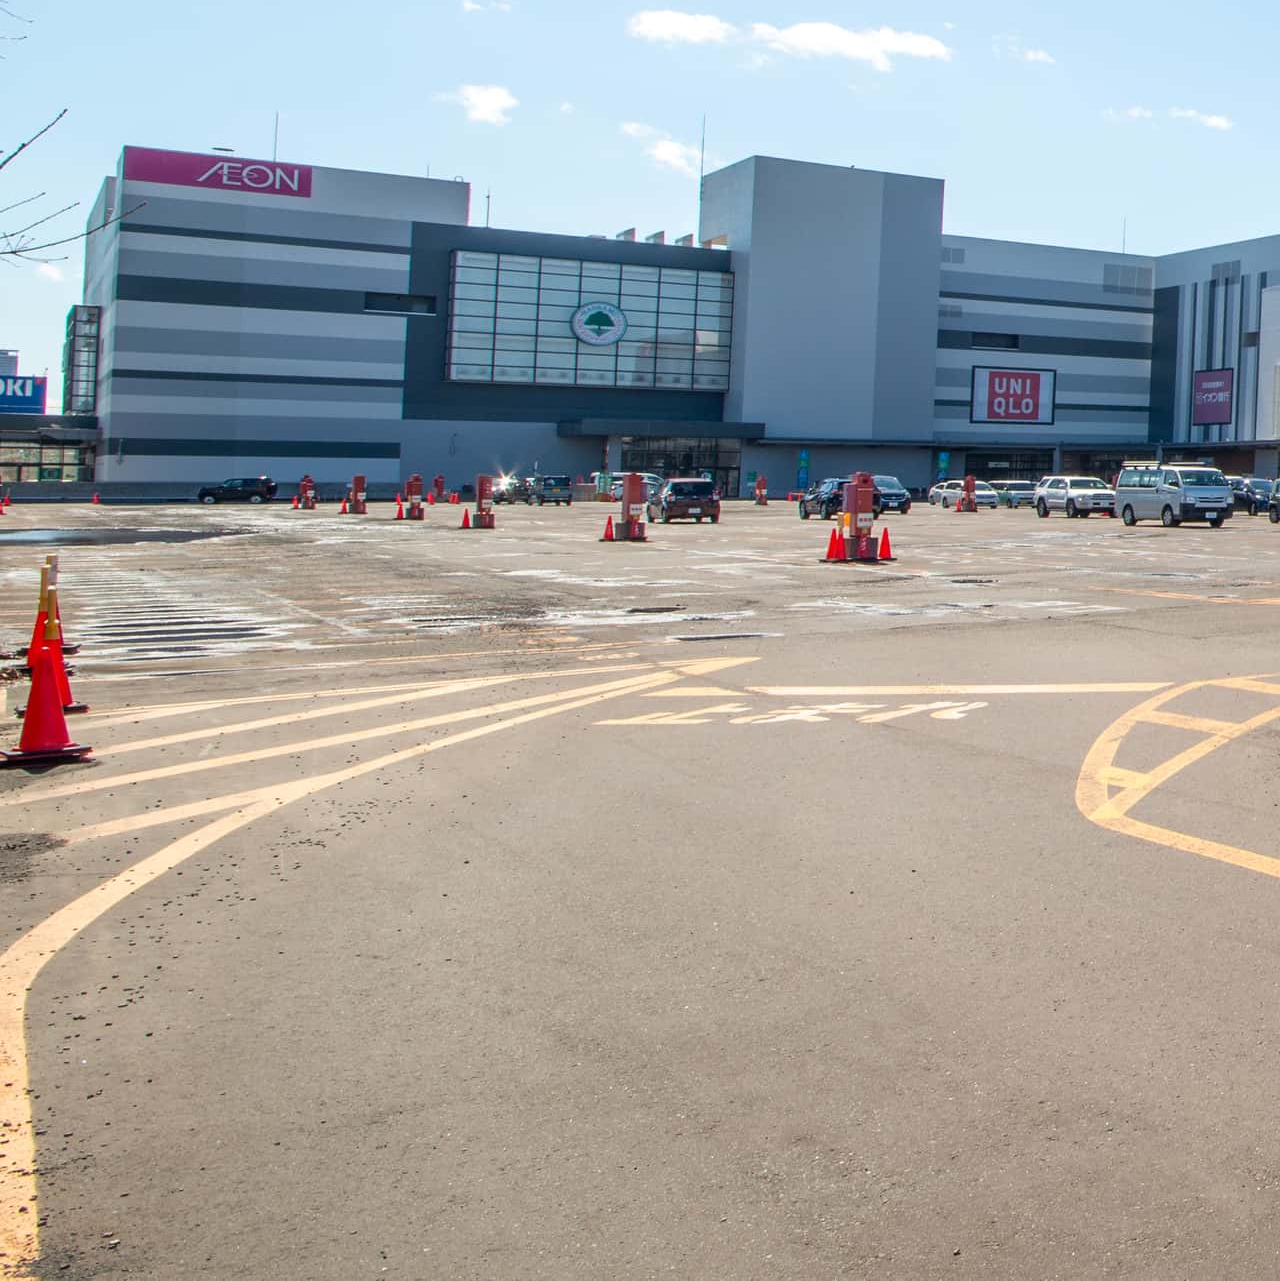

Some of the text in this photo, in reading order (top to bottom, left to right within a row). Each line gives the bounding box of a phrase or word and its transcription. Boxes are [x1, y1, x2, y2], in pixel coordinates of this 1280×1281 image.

[994, 377, 1032, 395] UNI
[993, 397, 1034, 416] QLO
[592, 701, 989, 725] 止まれ
